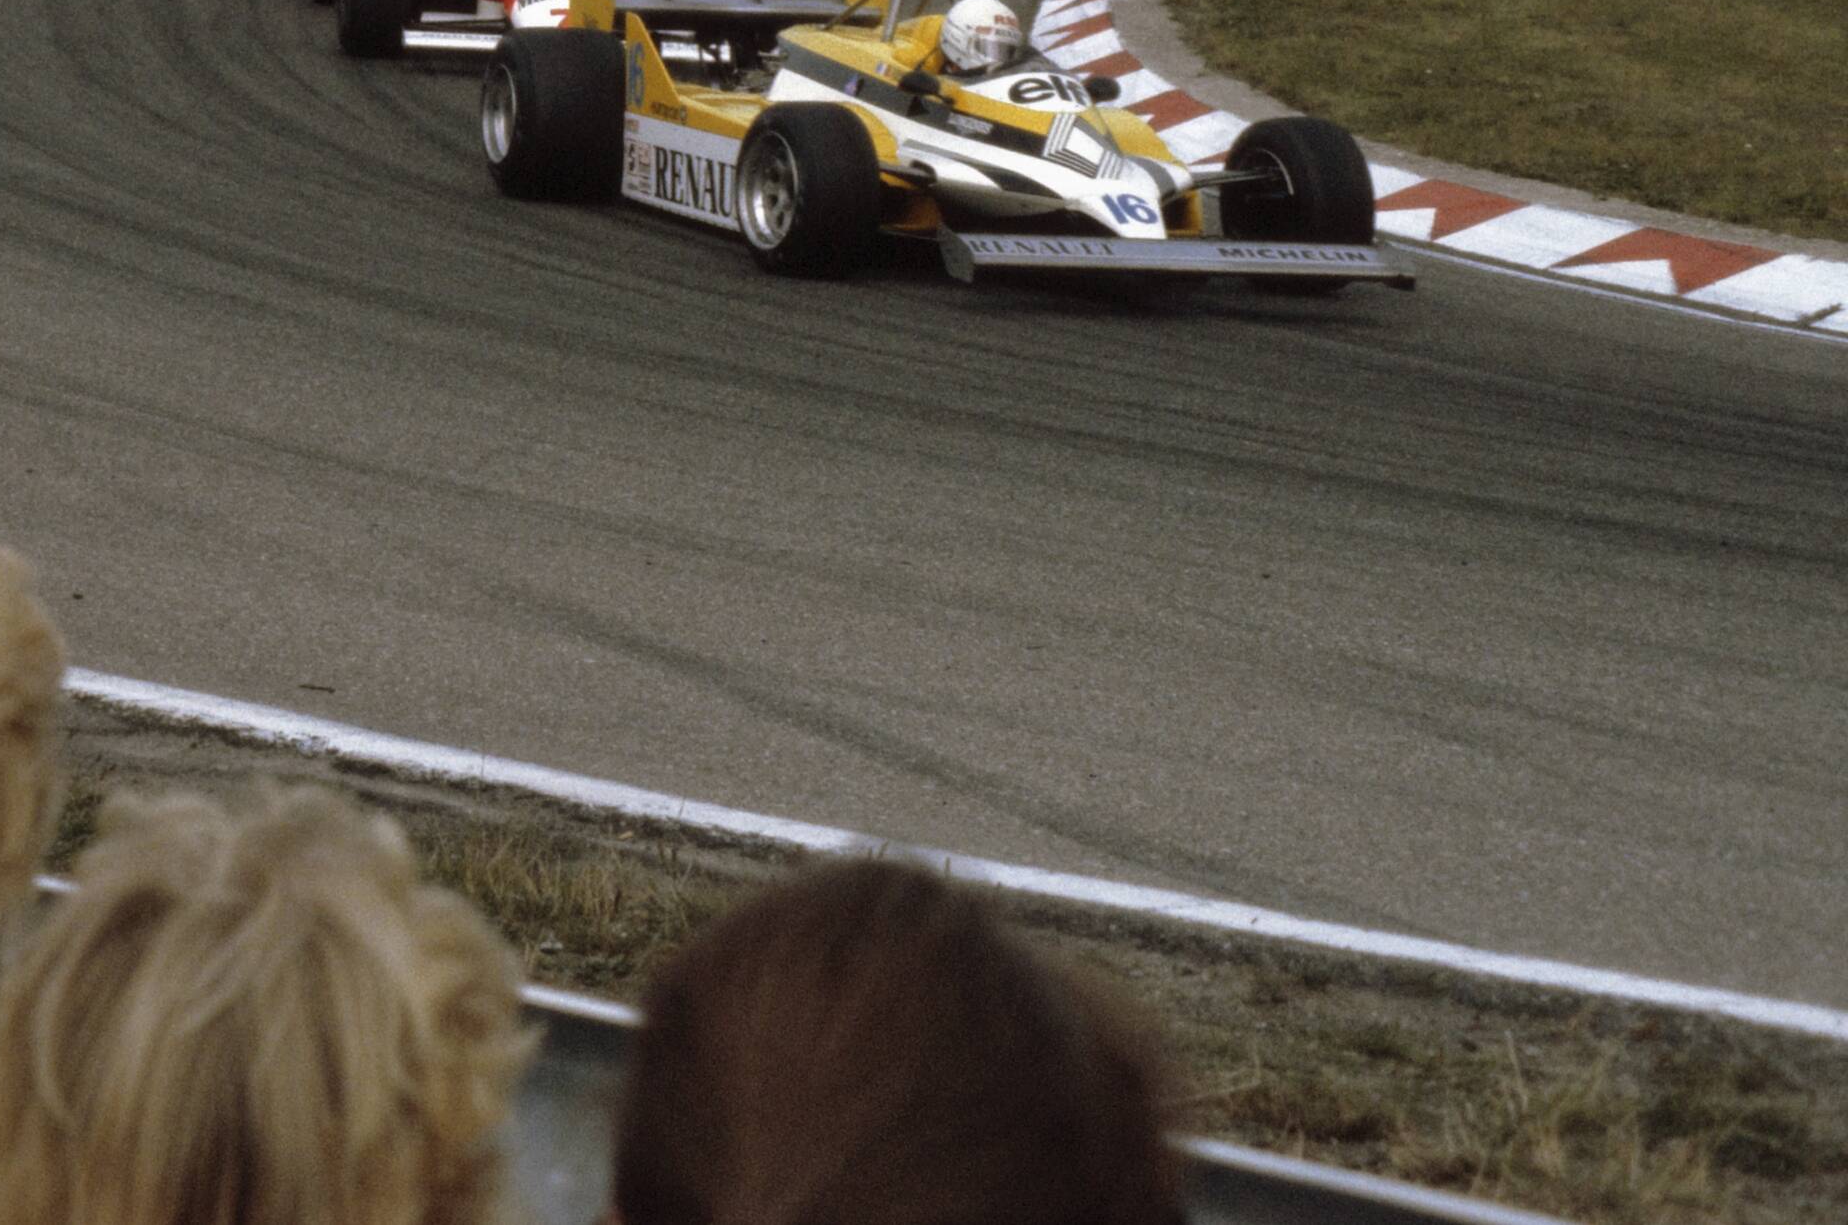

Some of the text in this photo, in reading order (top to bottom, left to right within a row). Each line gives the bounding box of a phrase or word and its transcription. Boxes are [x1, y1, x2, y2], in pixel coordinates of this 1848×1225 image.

[1008, 75, 1090, 106] elf
[1101, 193, 1159, 225] 16
[969, 239, 1116, 257] RENAULT
[1216, 246, 1369, 263] MICHELIN
